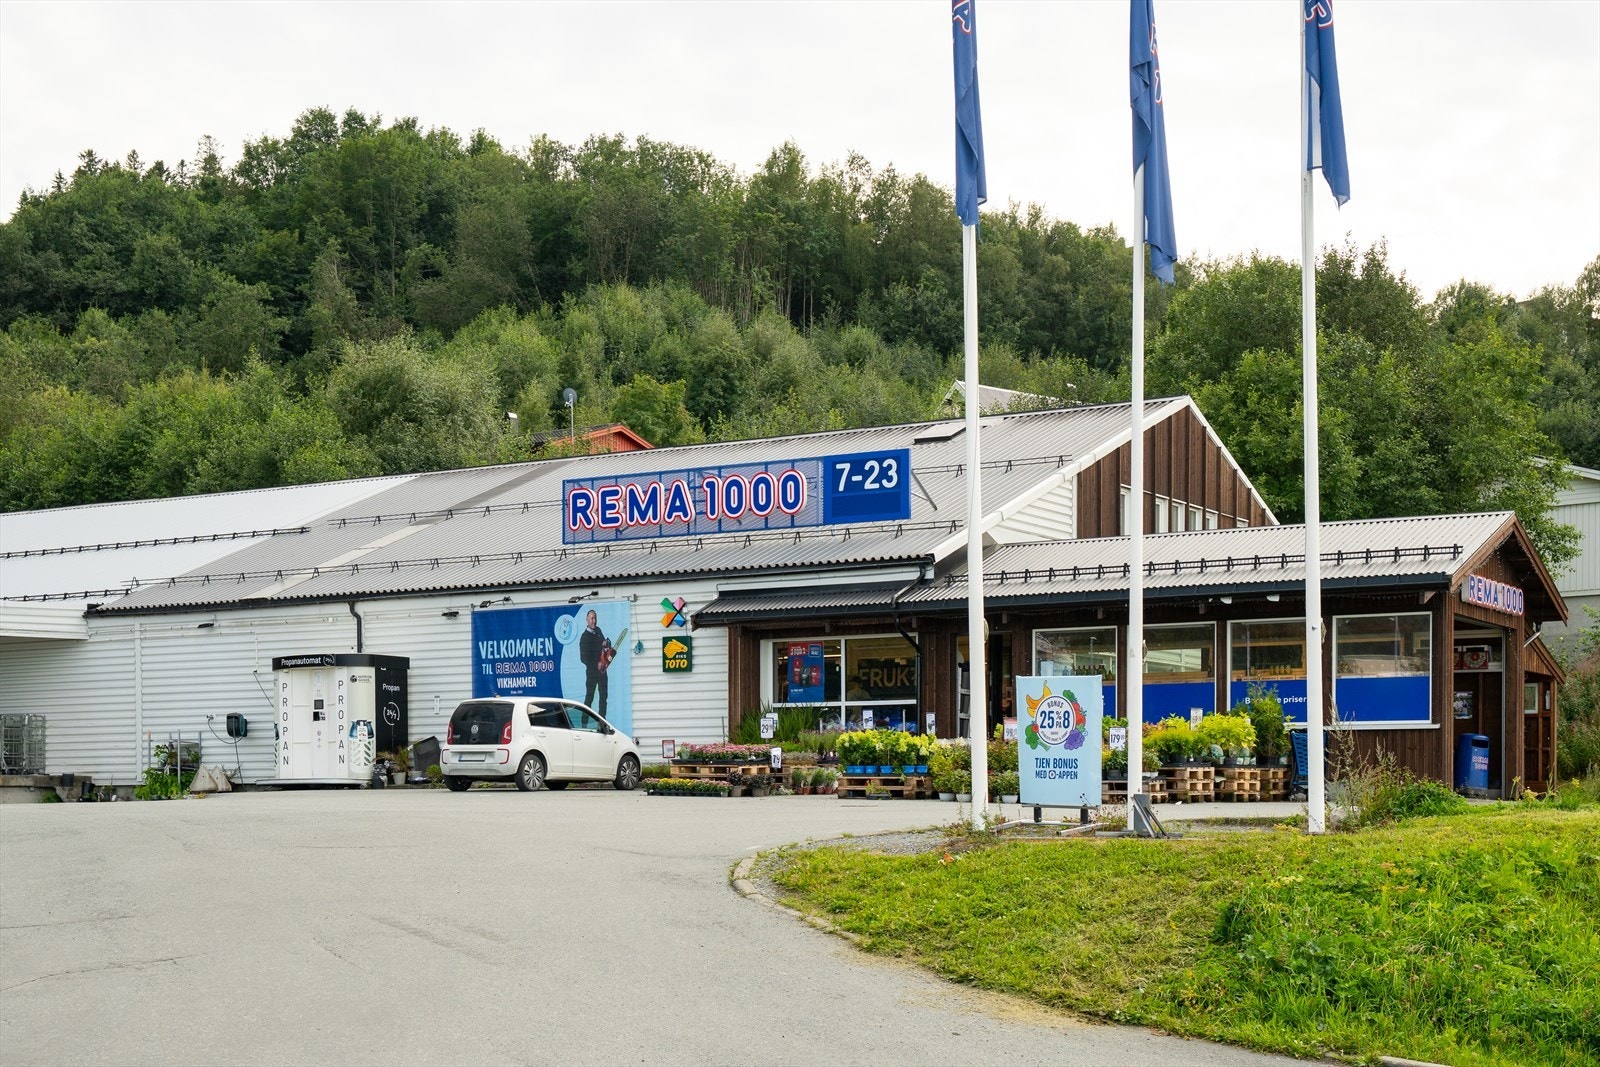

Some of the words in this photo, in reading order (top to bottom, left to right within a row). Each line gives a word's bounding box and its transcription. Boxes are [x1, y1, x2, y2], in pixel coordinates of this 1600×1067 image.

[835, 458, 898, 492] 7-23
[568, 480, 695, 531] REMA
[702, 469, 807, 520] 1000
[1469, 573, 1499, 609] REMA
[1502, 583, 1524, 615] 1000
[478, 637, 554, 659] VELKOMMEN
[281, 657, 321, 667] Propanautomat
[482, 664, 494, 675] TIL
[496, 661, 527, 675] REMA
[528, 660, 555, 673] 1000
[665, 659, 688, 669] TOTO
[382, 683, 400, 692] Propan
[496, 676, 537, 689] VIKHAMMER
[1047, 700, 1064, 709] BONUS
[386, 709, 397, 719] 24/7
[1040, 710, 1055, 729] 25
[1063, 710, 1070, 729] 8
[1110, 734, 1121, 743] 179
[1035, 757, 1051, 769] TJEN
[1053, 758, 1079, 769] BONUS
[1035, 770, 1048, 779] MED
